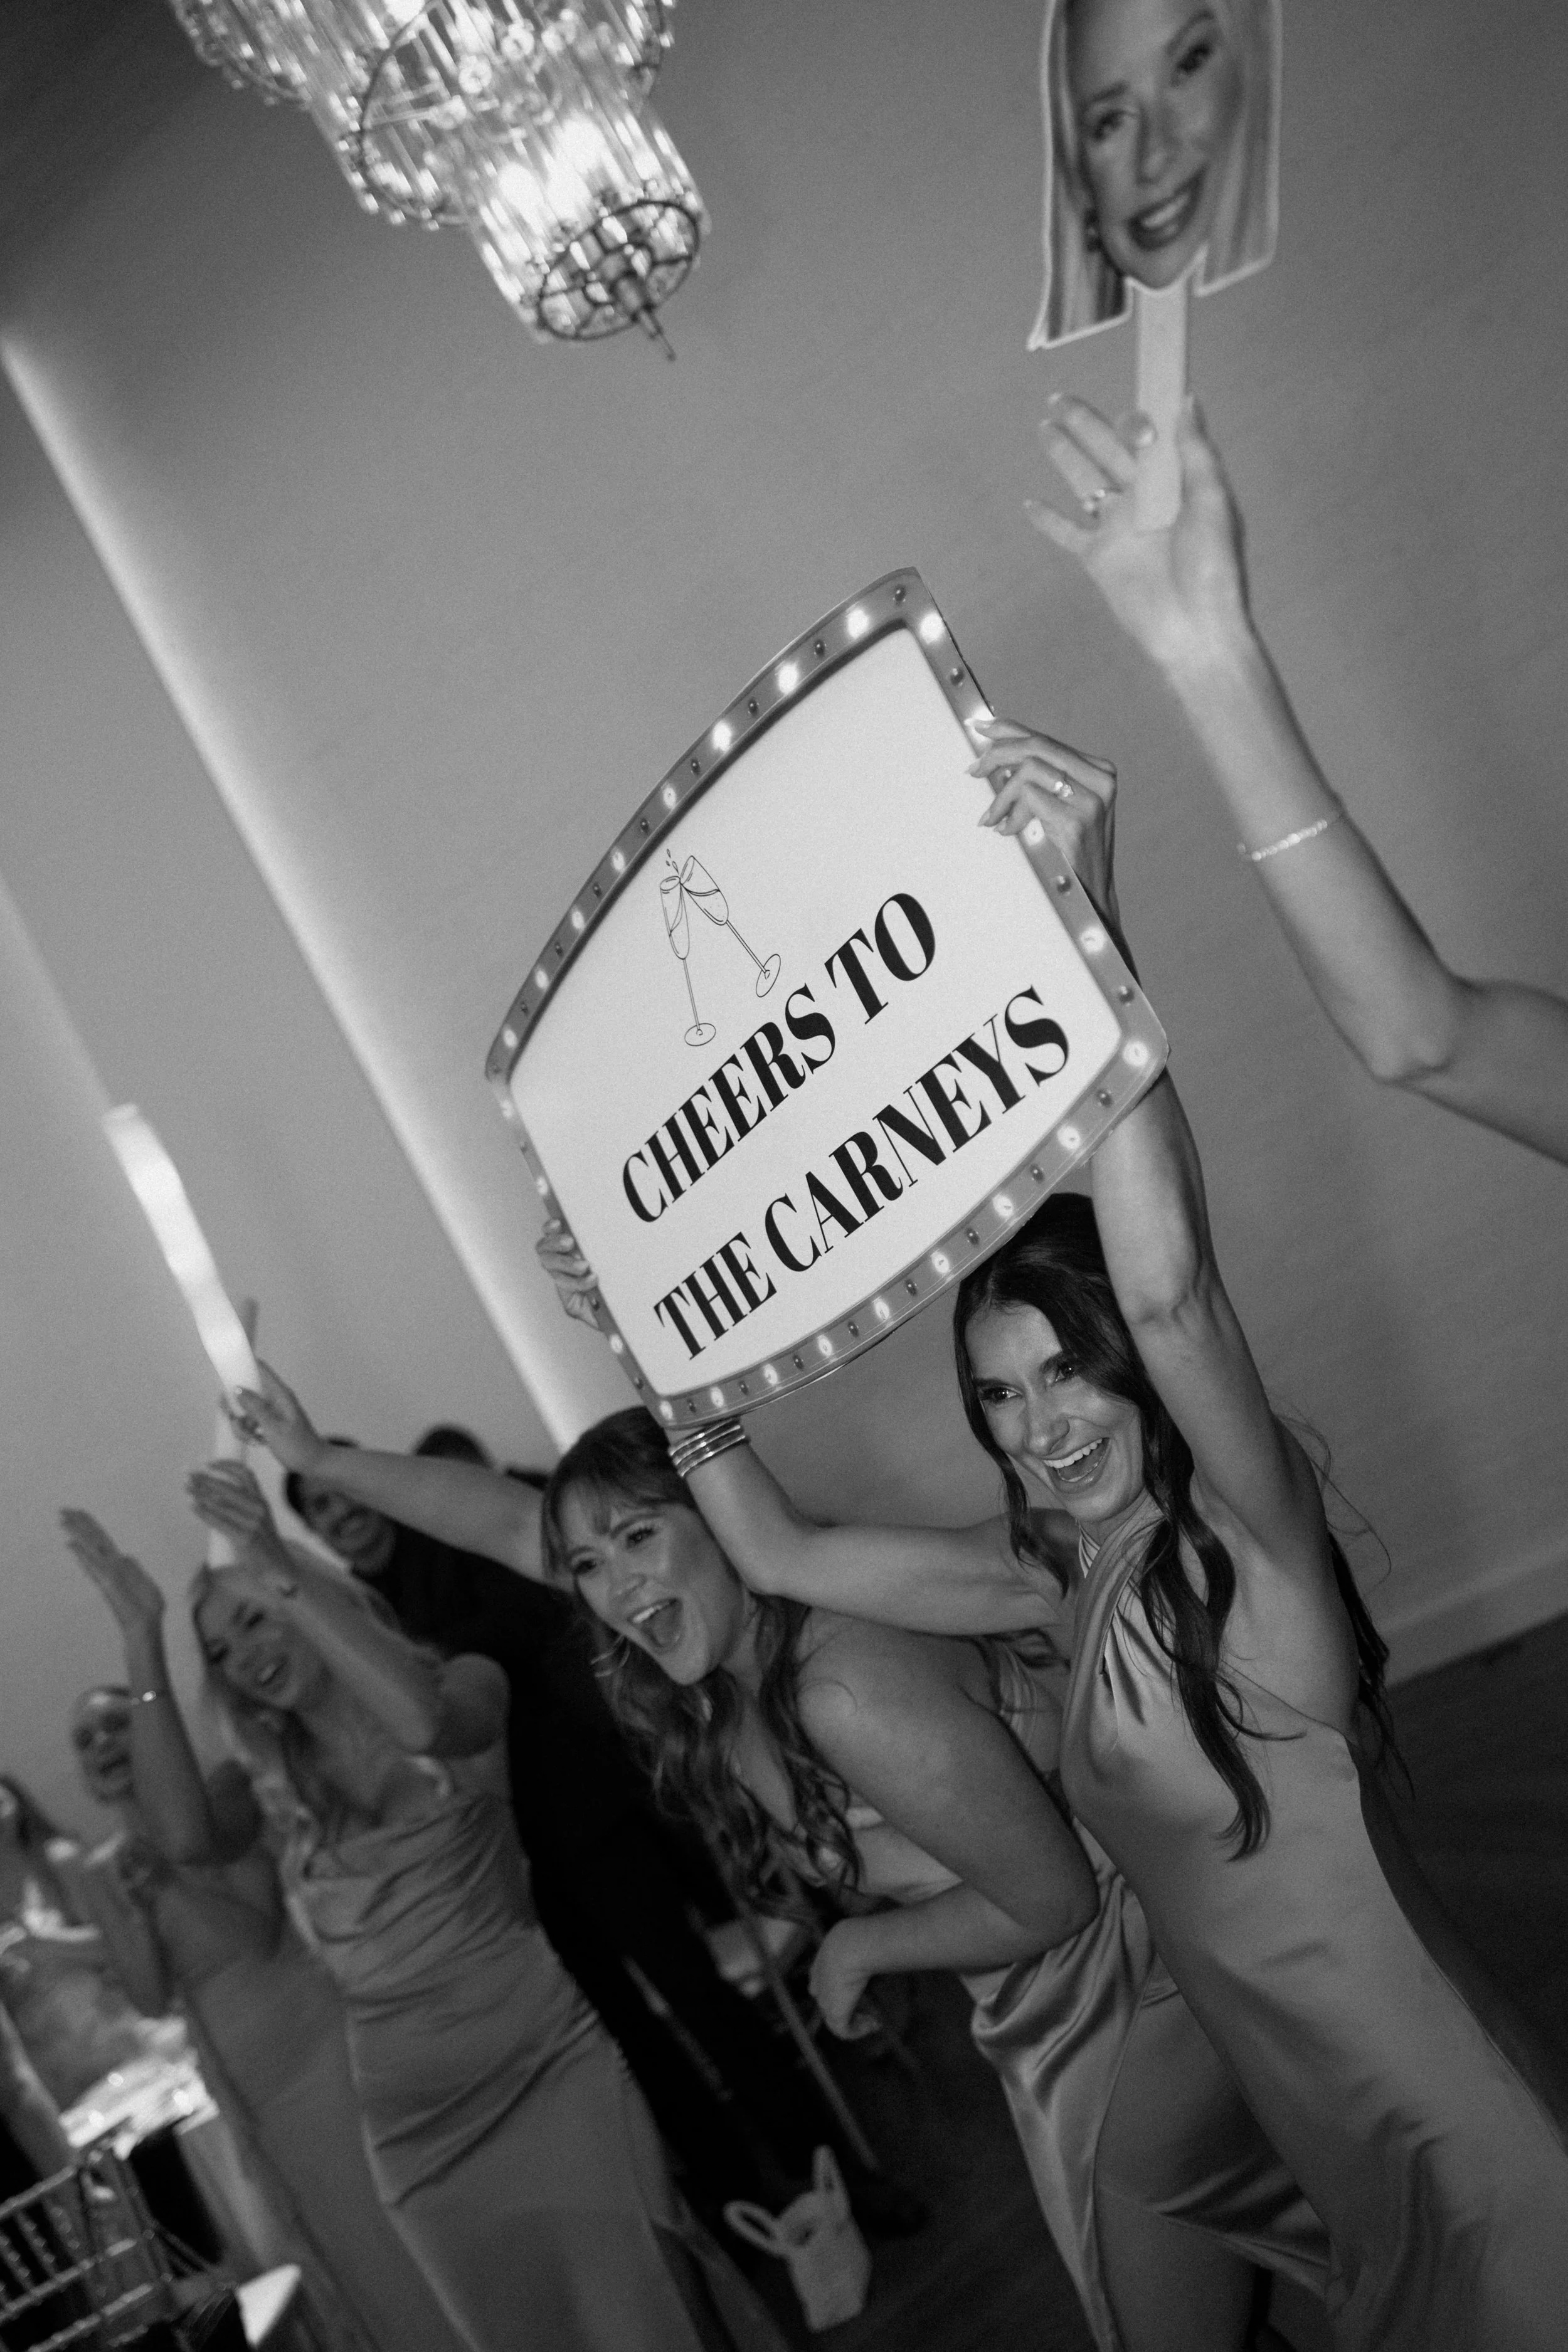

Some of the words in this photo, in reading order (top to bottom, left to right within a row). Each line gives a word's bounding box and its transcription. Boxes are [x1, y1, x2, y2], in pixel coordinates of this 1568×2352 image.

[622, 982, 836, 1223] CHEERS
[824, 893, 936, 1025] TO
[653, 1231, 778, 1360] THE
[764, 985, 1069, 1273] CARNEYS
